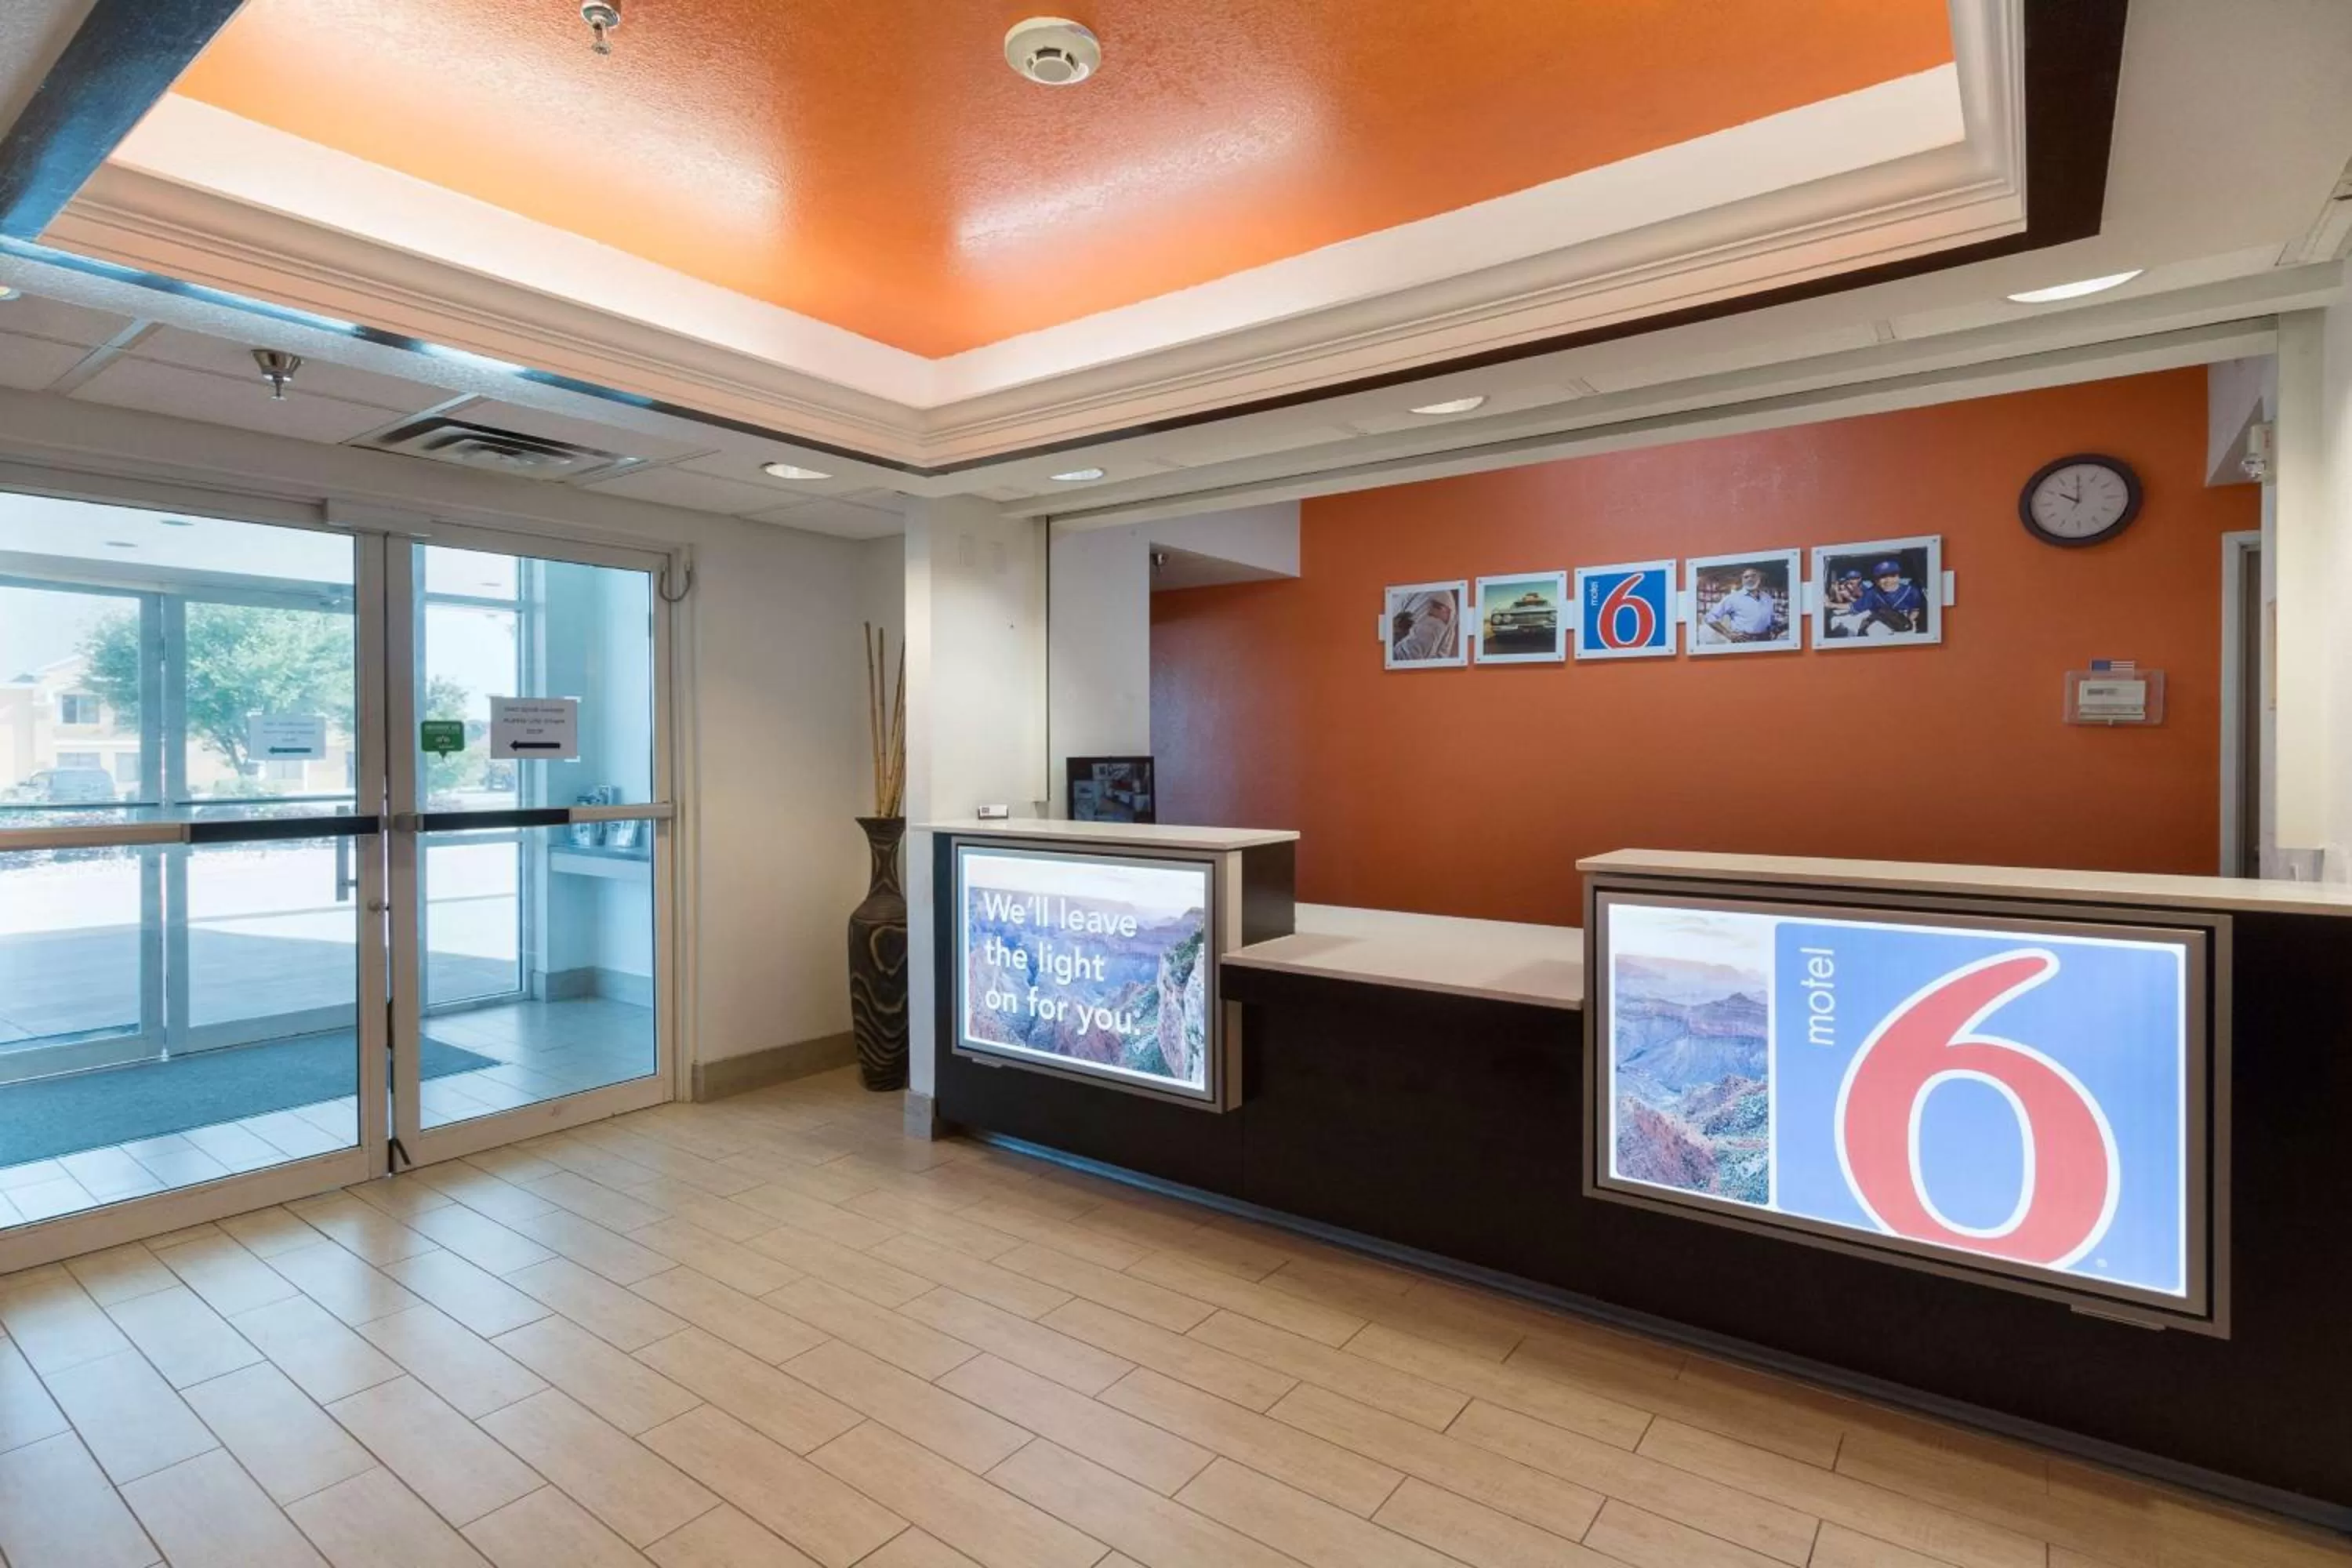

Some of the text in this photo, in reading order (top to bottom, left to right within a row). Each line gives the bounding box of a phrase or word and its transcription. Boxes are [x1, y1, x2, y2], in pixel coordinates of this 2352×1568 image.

[1596, 573, 1656, 650] 6
[983, 891, 1137, 937] We'll leave
[985, 936, 1105, 985] the light
[985, 988, 1017, 1014] on
[1026, 985, 1069, 1022] for
[1798, 946, 2121, 1272] motel 6
